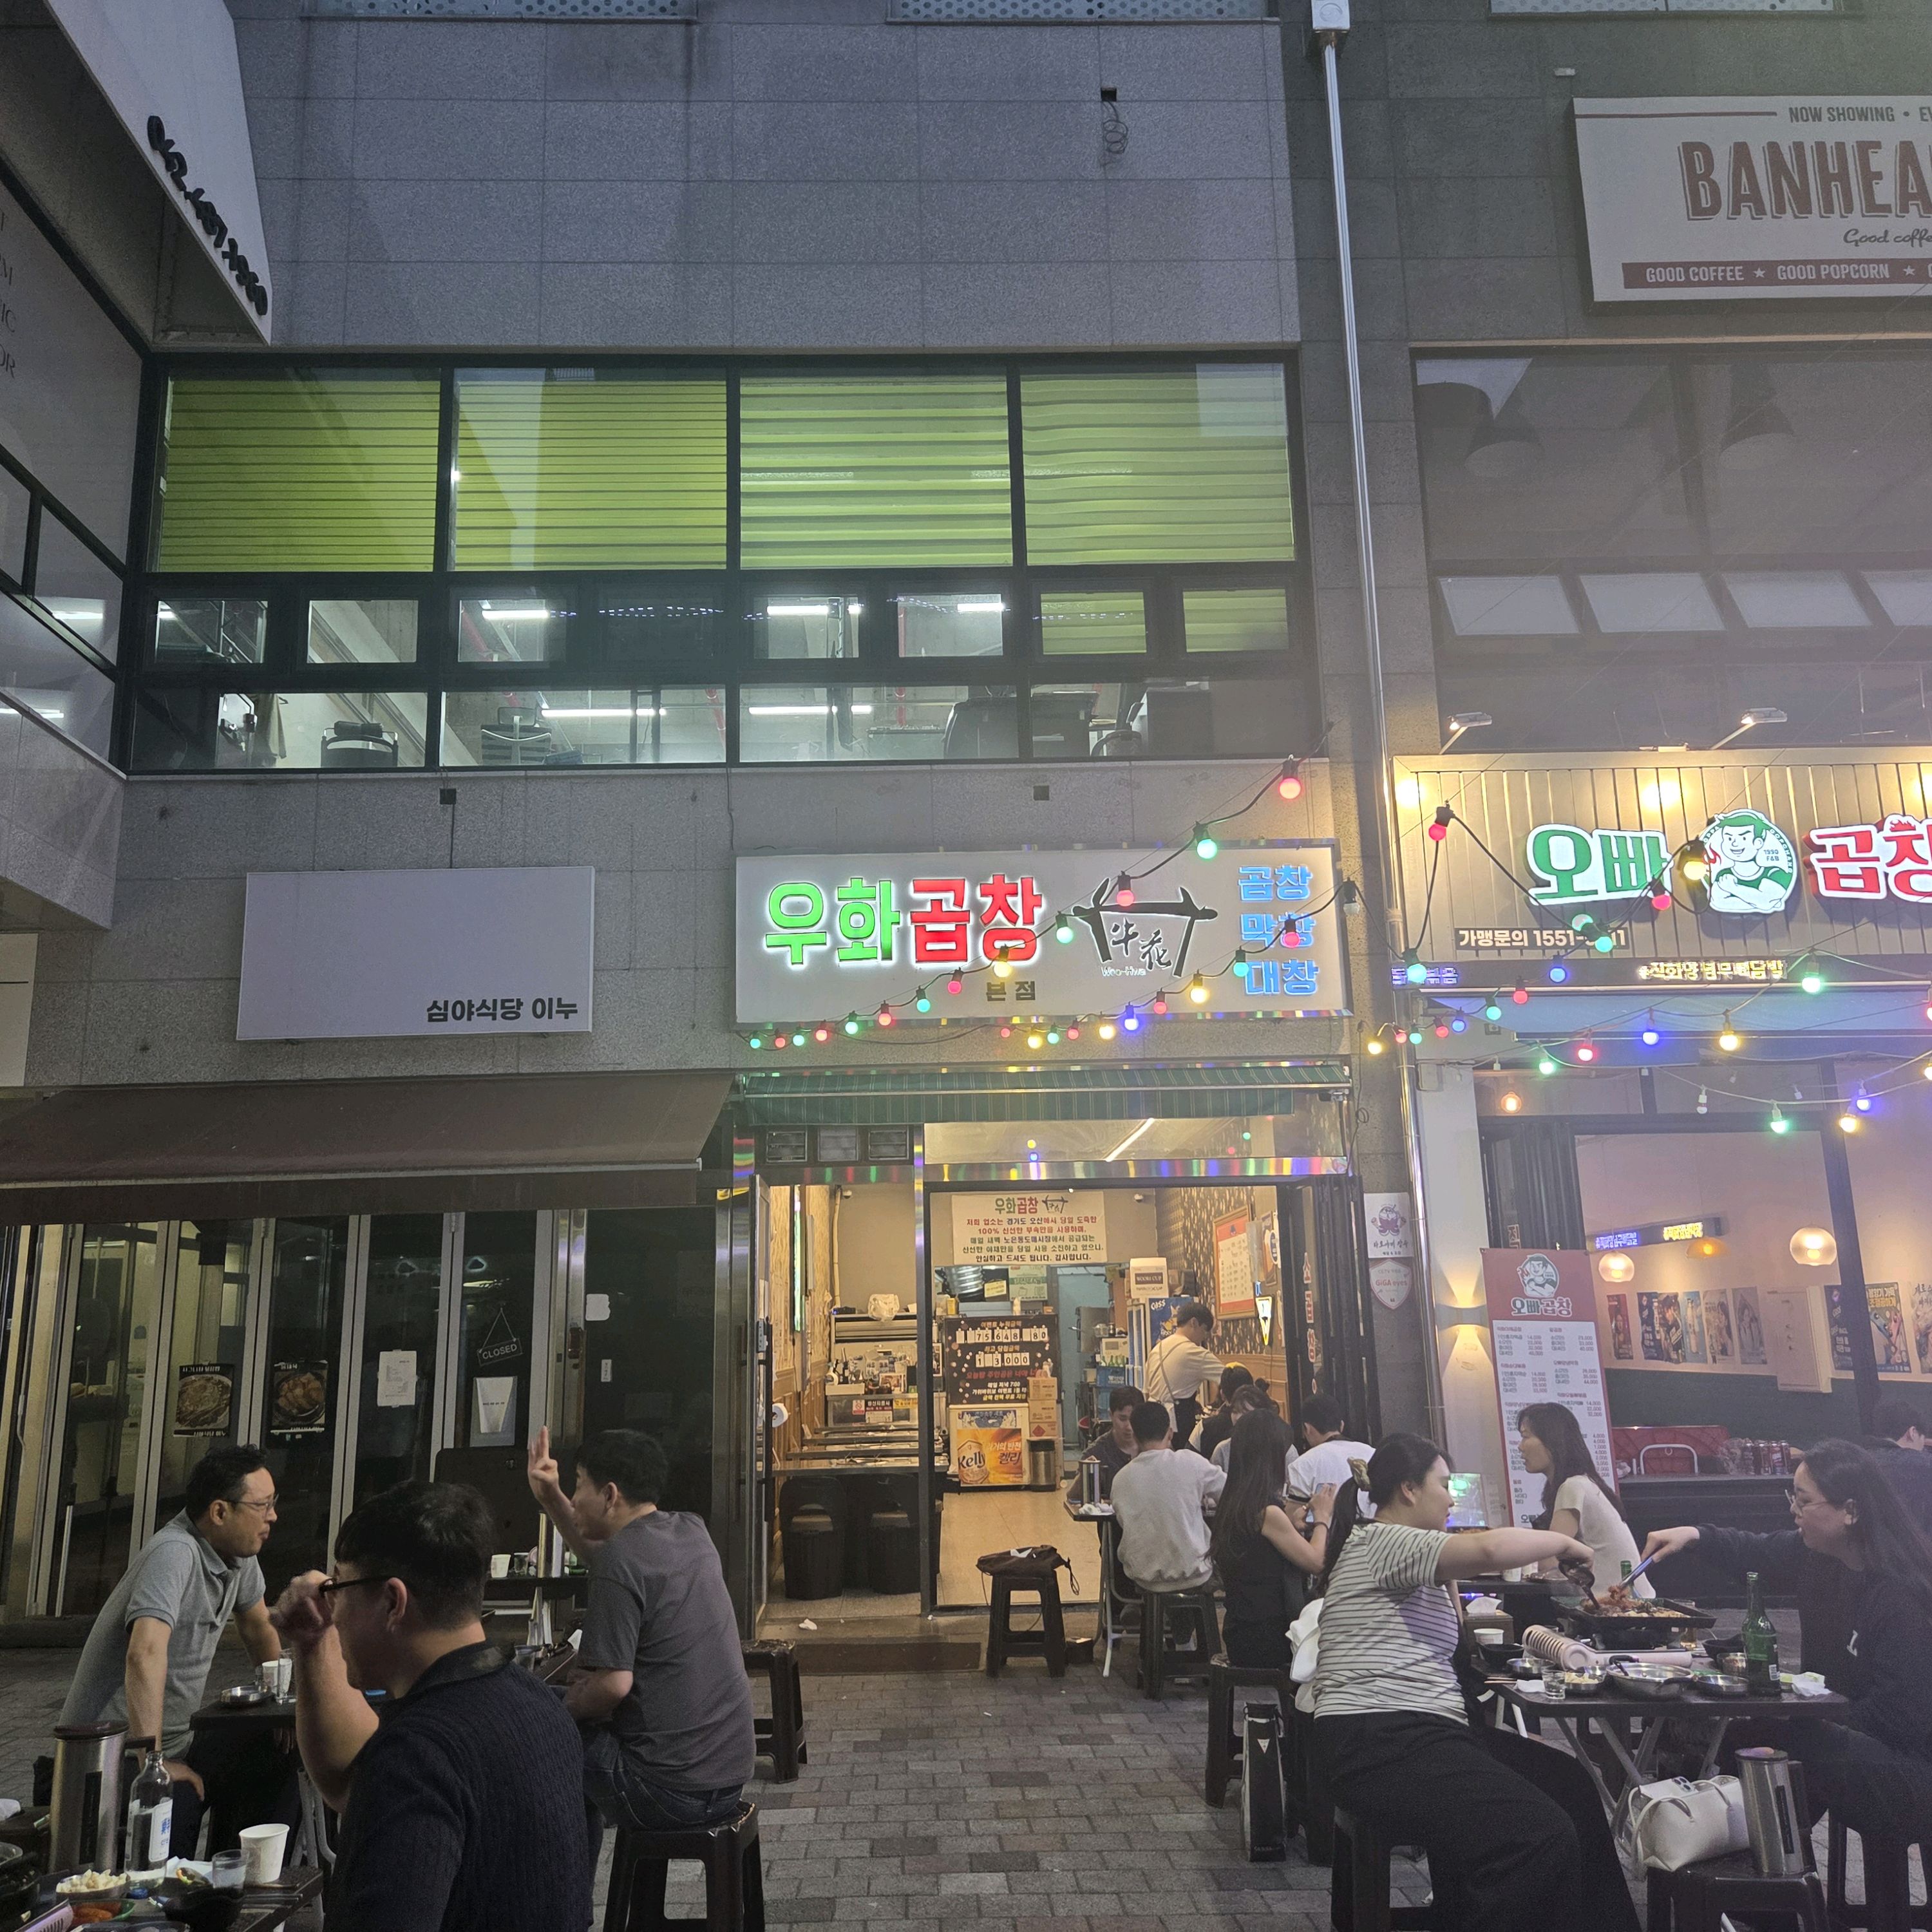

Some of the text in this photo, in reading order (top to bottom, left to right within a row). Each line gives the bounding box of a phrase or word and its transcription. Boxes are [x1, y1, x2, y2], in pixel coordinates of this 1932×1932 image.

[1788, 106, 1822, 123] NOW
[1826, 106, 1895, 122] SHOWING
[1843, 229, 1889, 247] Good
[1645, 263, 1890, 283] GOOD COFFEE GOOD POPCORN
[1529, 826, 1673, 903] 오빠
[1238, 864, 1313, 901] 곱창
[765, 874, 1043, 965] 우화곱창
[1459, 929, 1529, 947] 가맹문의
[1245, 958, 1320, 996] 대창
[426, 997, 578, 1023] 심야식당 이누
[994, 1197, 1039, 1215] 우화곱창
[987, 1236, 1001, 1244] 새벽
[1511, 1297, 1572, 1316] 오빠곱창
[482, 1343, 518, 1360] CLOSED
[958, 1450, 985, 1469] Kelly
[999, 1451, 1022, 1466] 켈리
